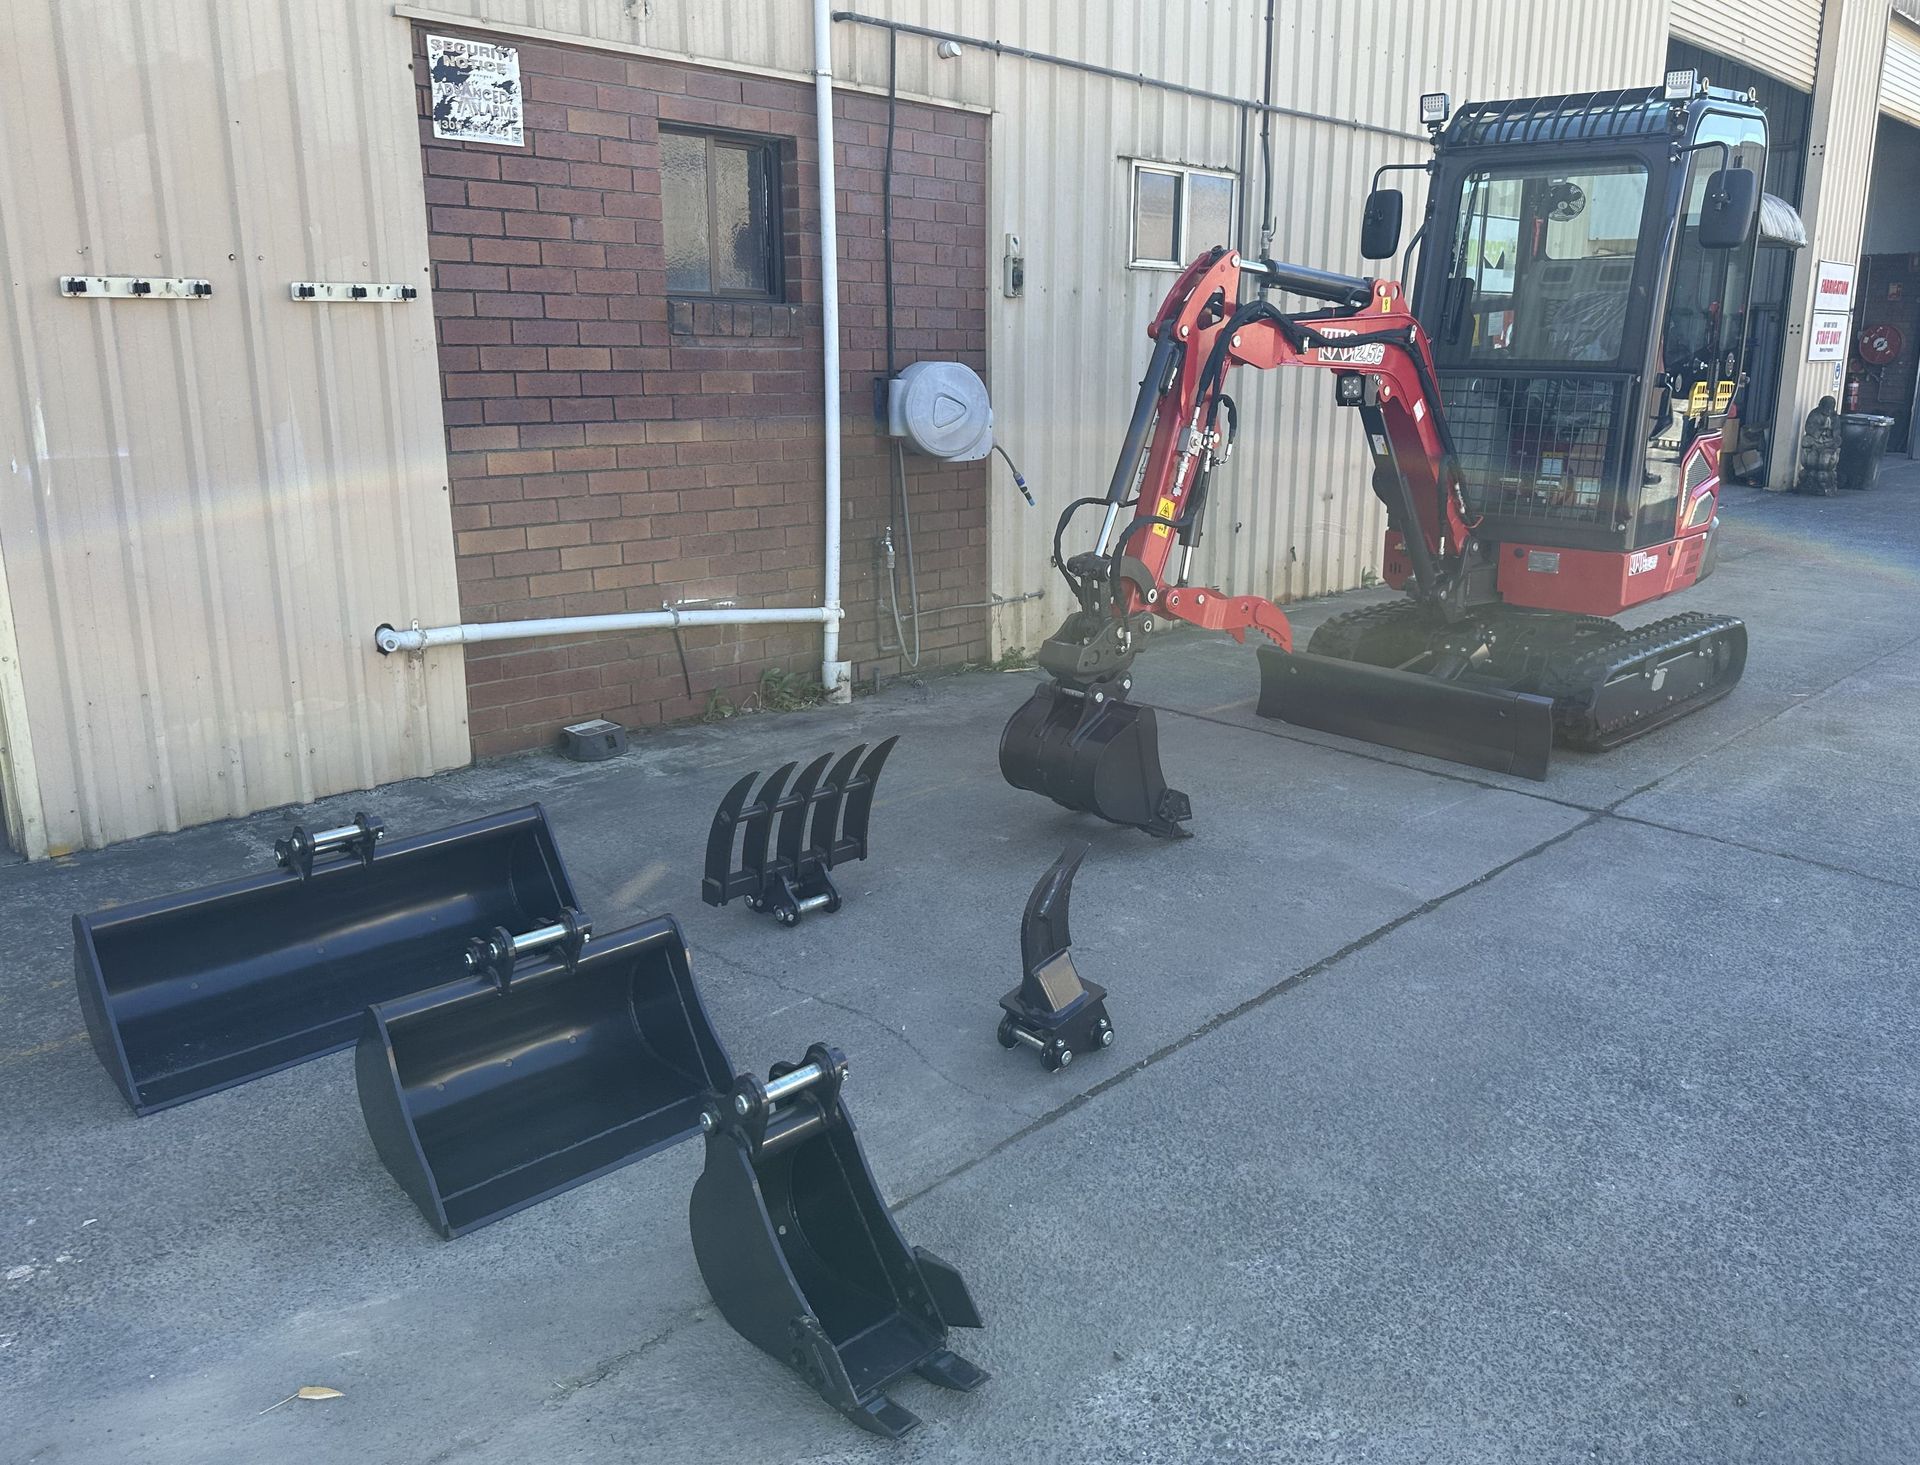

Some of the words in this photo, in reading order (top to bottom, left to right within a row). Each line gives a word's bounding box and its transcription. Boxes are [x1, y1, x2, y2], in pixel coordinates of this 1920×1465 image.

[431, 39, 515, 62] SECURITY
[443, 55, 507, 75] NOTICE
[436, 82, 509, 104] ADVANCED
[1820, 278, 1849, 295] FABRICATION
[1815, 331, 1831, 345] STAFF
